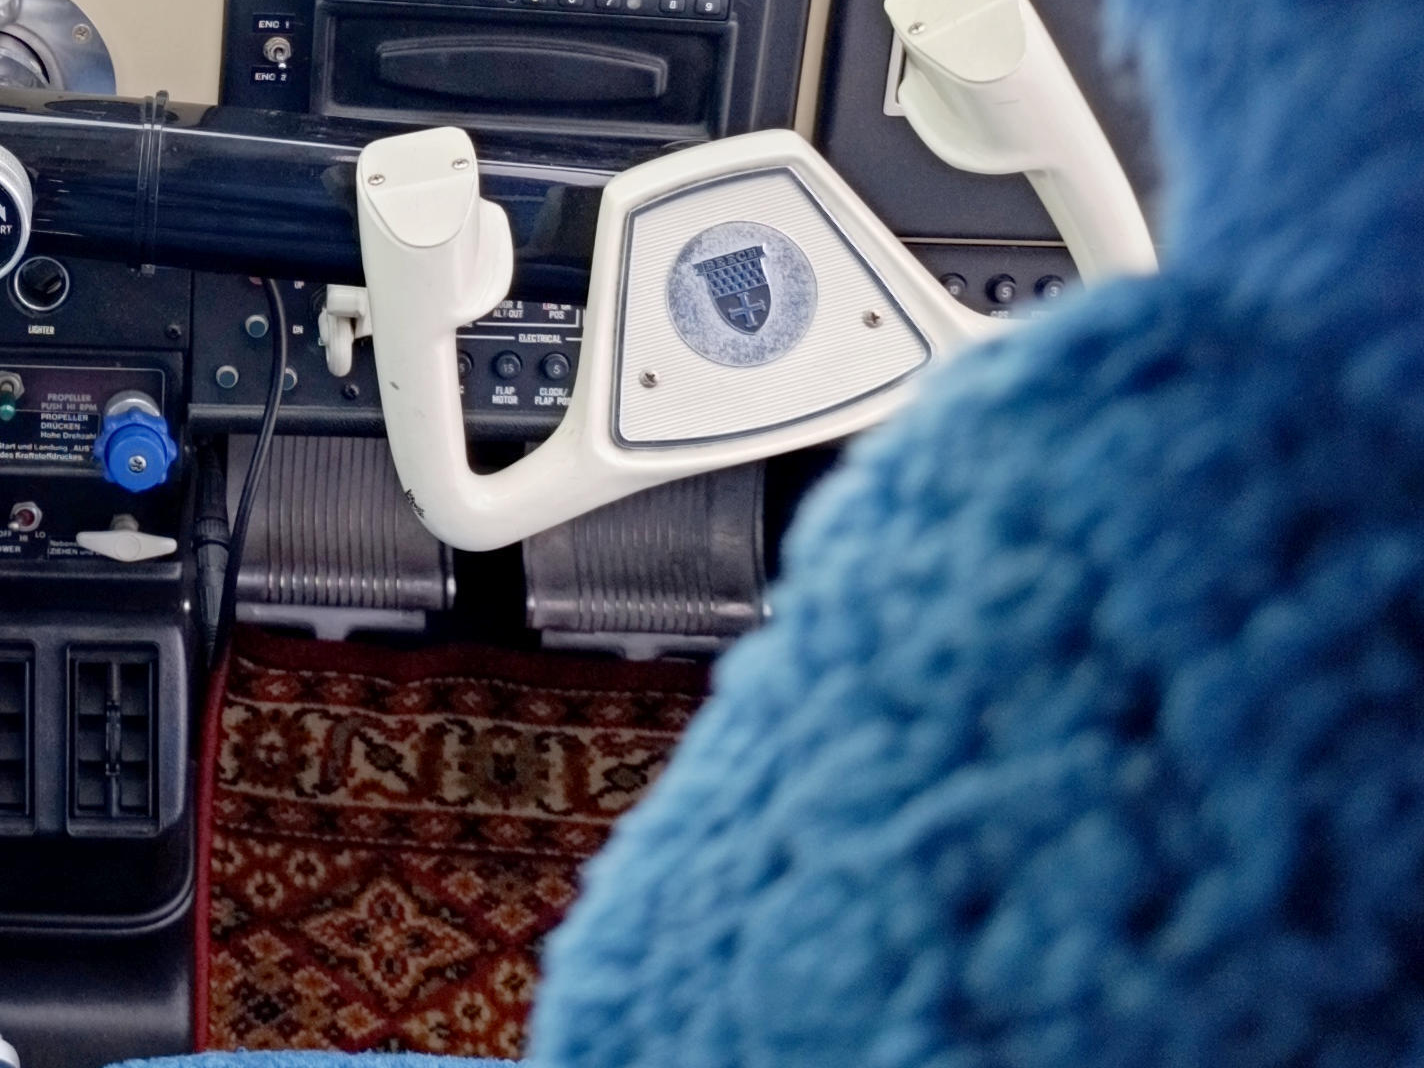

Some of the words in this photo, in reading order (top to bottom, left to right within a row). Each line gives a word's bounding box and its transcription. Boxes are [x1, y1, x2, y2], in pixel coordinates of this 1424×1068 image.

[703, 247, 756, 272] BEECH
[27, 324, 55, 335] LIGHTER
[518, 334, 562, 344] ELECTRICAL
[495, 386, 515, 396] FLAP
[47, 393, 92, 403] PROPELLER
[492, 395, 519, 406] MOTOR
[534, 395, 555, 406] FLAP
[41, 402, 63, 411] PUSH
[79, 403, 98, 412] RPM
[40, 412, 89, 422] PROPELLER
[17, 442, 33, 451] und
